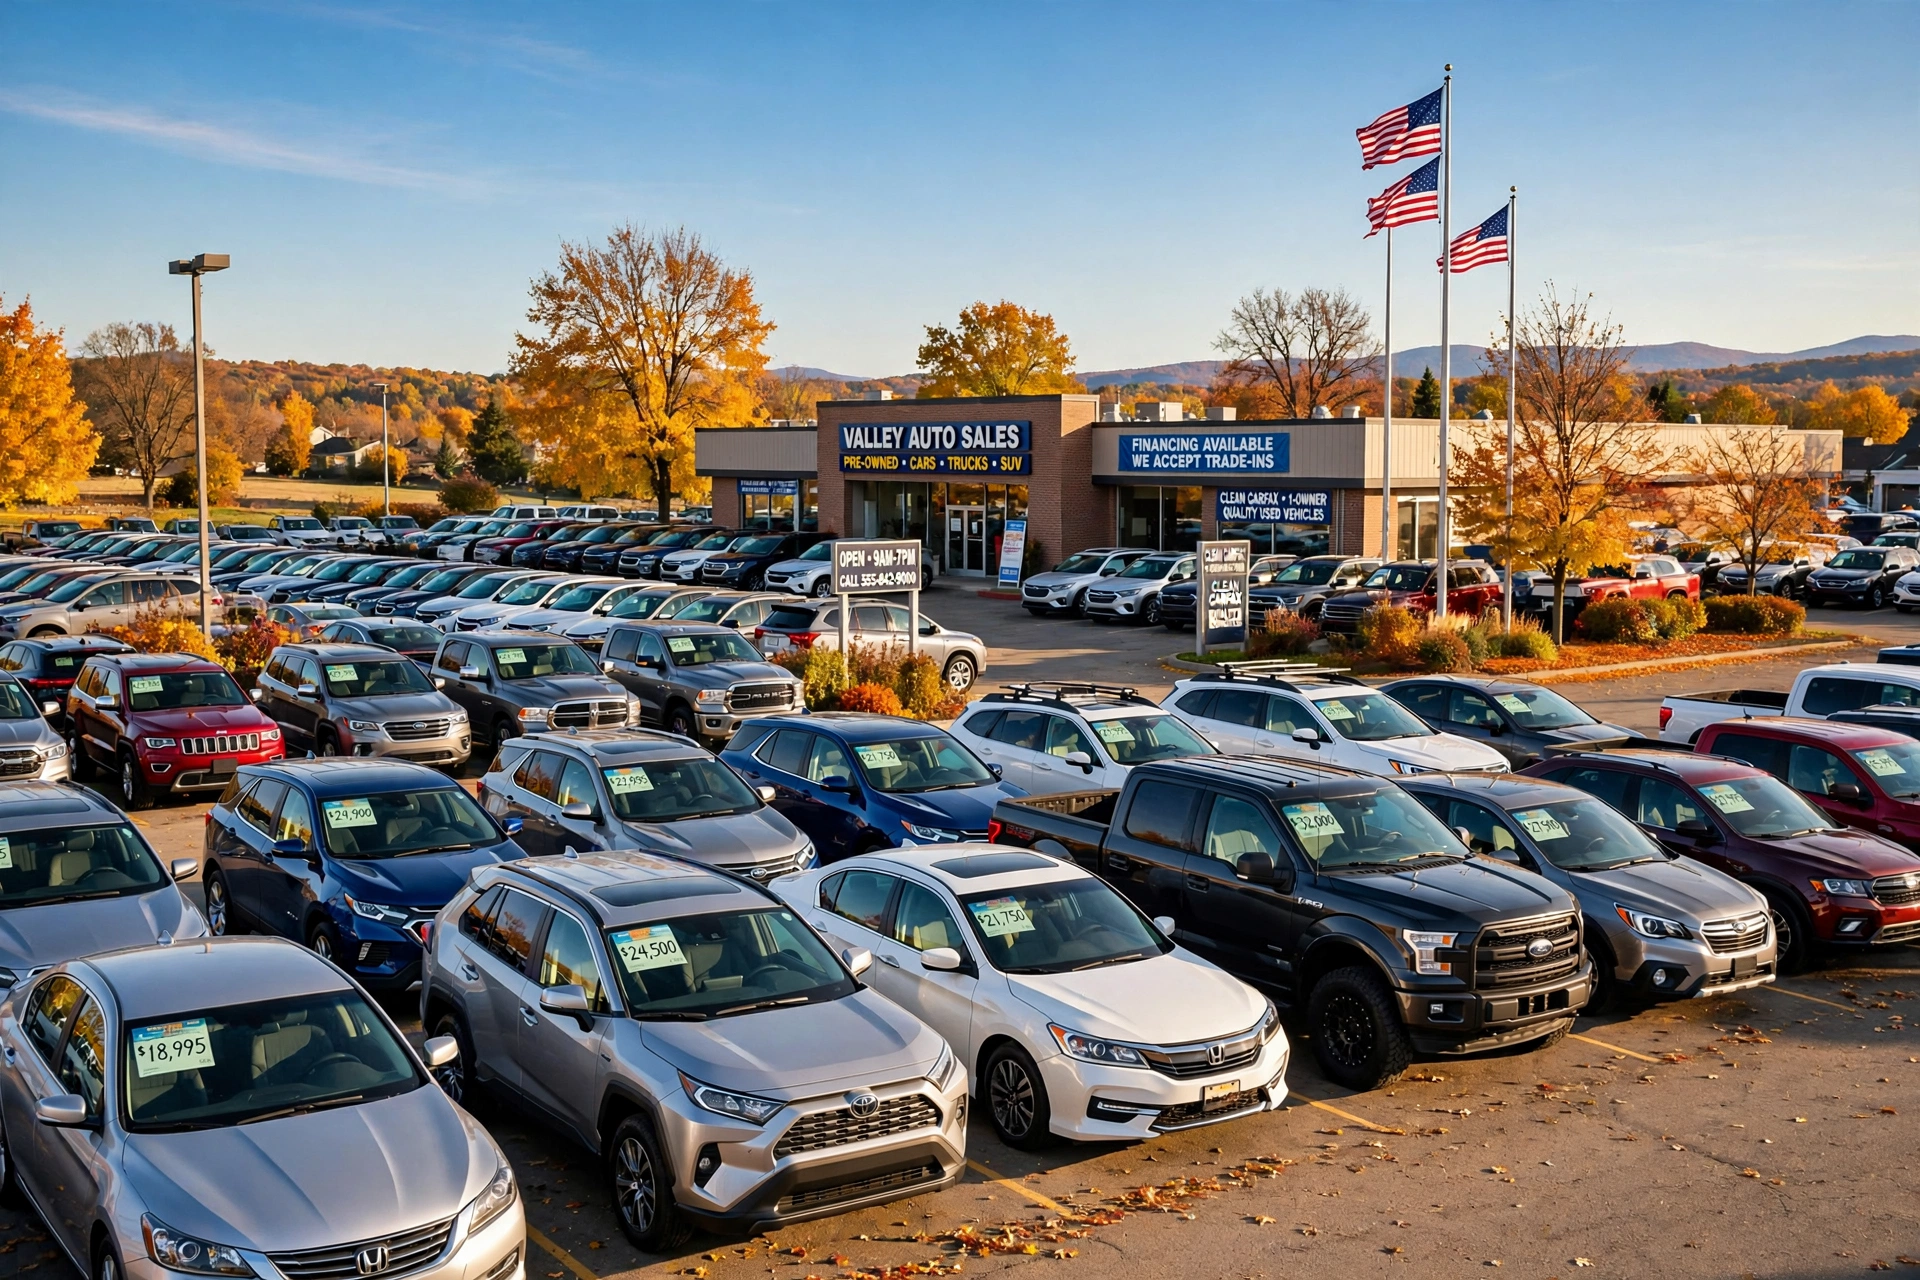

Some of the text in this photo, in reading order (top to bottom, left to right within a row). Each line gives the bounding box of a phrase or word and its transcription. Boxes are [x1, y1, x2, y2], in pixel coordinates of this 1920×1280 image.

[843, 424, 1020, 449] VALLEY AUTO SALES
[1132, 436, 1274, 452] FINANCING AVAILABLE
[843, 455, 1022, 471] PRE-OWNED CARS TRUCKS SUV
[1132, 454, 1275, 469] WE ACCEPT TRADE-INS
[1219, 491, 1328, 507] CLEAN CARFAX 1-OWNER
[1223, 506, 1325, 521] QUALITY USED VEHICLES
[840, 548, 917, 568] OPEN 9AM-7PM
[840, 574, 860, 588] CALL
[977, 909, 1025, 927] $21,750
[620, 940, 677, 961] $24,500
[137, 1036, 206, 1062] $18,995
